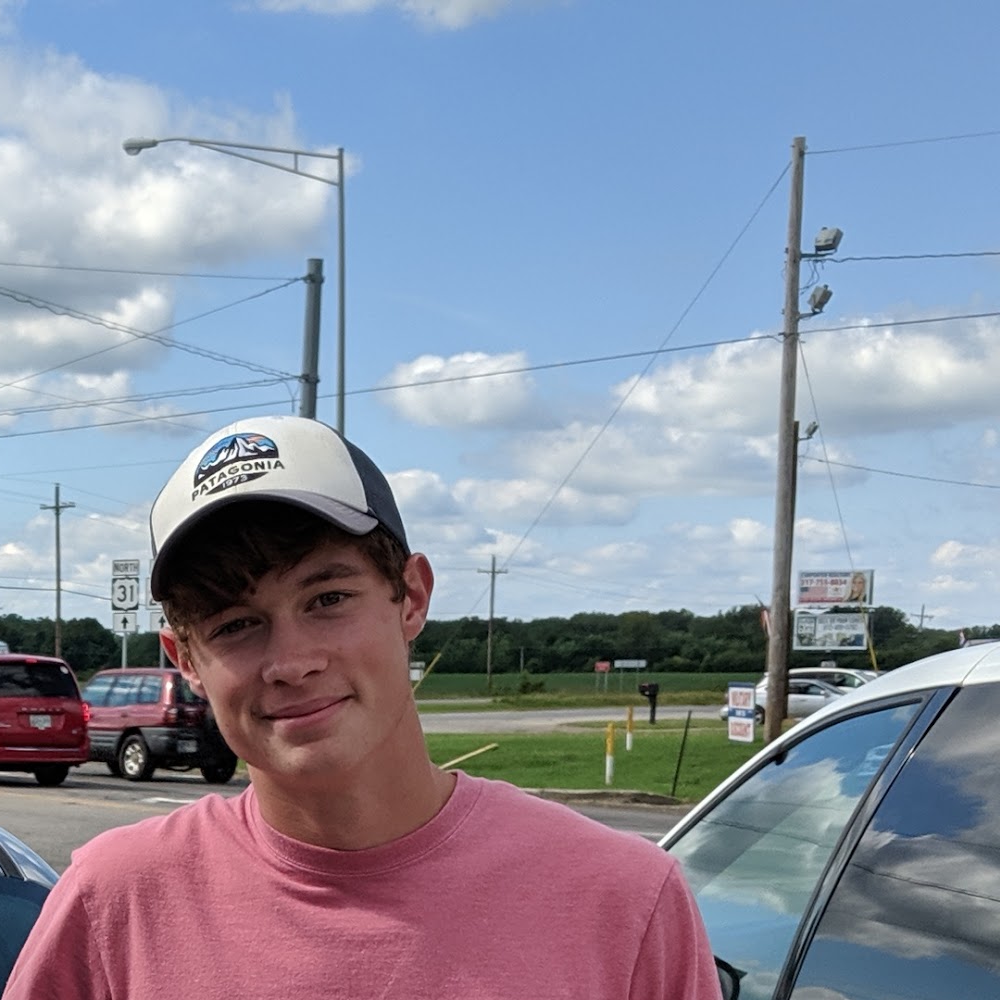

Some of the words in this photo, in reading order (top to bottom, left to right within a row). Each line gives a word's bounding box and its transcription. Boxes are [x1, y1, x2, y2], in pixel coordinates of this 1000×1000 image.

[191, 460, 285, 501] PATAGONIA
[222, 474, 248, 488] 1973
[113, 563, 138, 572] NORTH
[117, 585, 134, 602] 31
